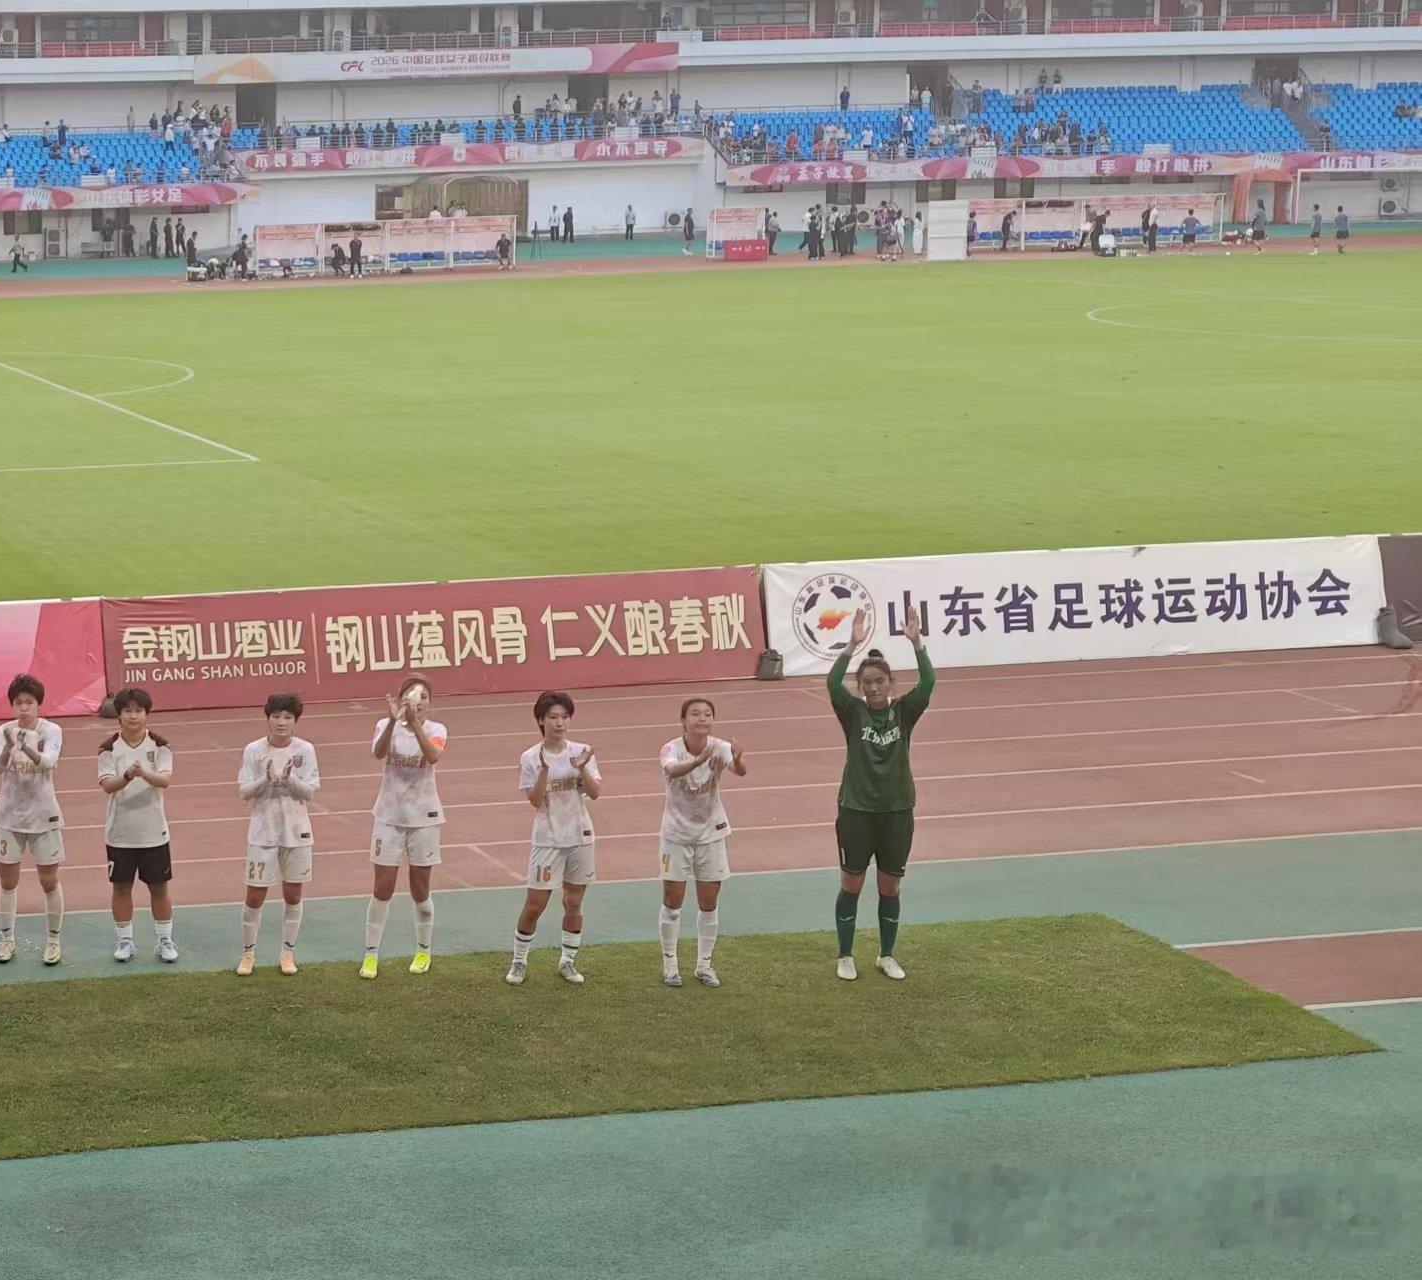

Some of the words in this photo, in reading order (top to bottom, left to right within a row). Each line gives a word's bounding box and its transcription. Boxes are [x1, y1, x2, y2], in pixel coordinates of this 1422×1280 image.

[370, 56, 399, 66] 2026
[888, 566, 1351, 639] 山东省足球运动协会
[122, 617, 306, 666] 金钢山酒业
[325, 605, 528, 674] 钢山蕴风骨
[541, 591, 752, 662] 仁义酿春秋
[124, 668, 147, 684] JIN
[151, 665, 196, 683] GANG
[200, 662, 244, 681] SHAN
[250, 660, 307, 680] LIQUOR
[248, 860, 266, 880] 27
[536, 864, 552, 882] 16
